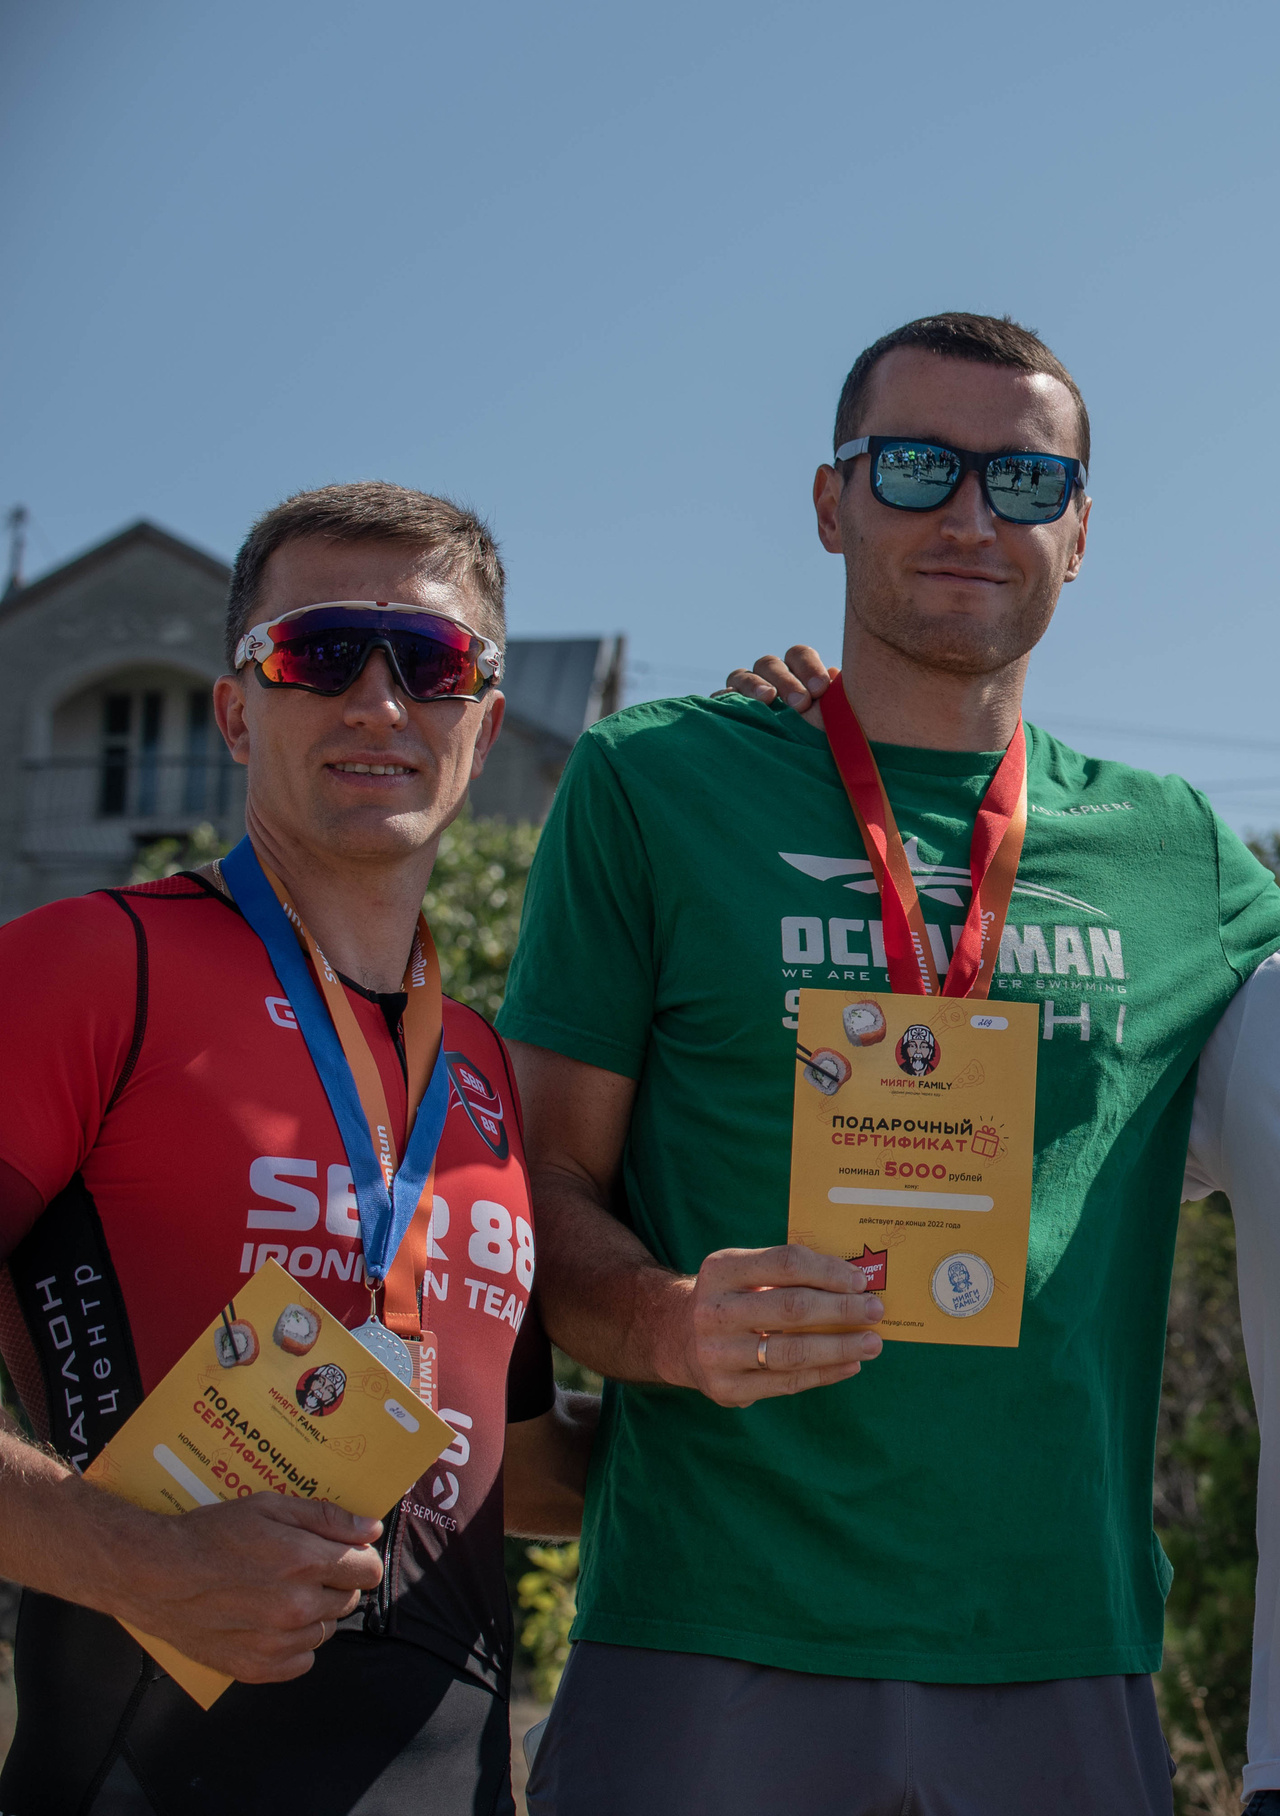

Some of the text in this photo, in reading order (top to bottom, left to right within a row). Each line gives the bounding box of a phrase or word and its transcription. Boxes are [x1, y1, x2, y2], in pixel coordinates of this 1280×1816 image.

[781, 916, 1125, 979] OCMAN
[782, 969, 870, 981] WE ARE
[1036, 980, 1127, 994] SWIMMING
[459, 1068, 487, 1096] SBR
[880, 1079, 952, 1090] МИЯГИ FAMILY
[481, 1115, 498, 1136] 88
[832, 1115, 973, 1136] ПОДАРОЧНЫЙ
[831, 1132, 968, 1152] СЕРТИФИКАТ
[838, 1161, 983, 1182] номинал 5000 рублей
[859, 1217, 894, 1226] действует
[895, 1219, 904, 1227] до
[928, 1220, 944, 1229] 2022
[945, 1222, 961, 1230] года
[468, 1200, 535, 1293] 88
[239, 1243, 450, 1302] IRONN
[268, 1387, 299, 1418] МИЯГИ
[297, 1415, 329, 1445] FAMILY
[193, 1400, 300, 1499] СЕРТИФИКАТ
[203, 1385, 319, 1497] ПОДАРОЧНЫЙ
[178, 1432, 253, 1499] номинал 200
[413, 1502, 457, 1532] SERVICES
